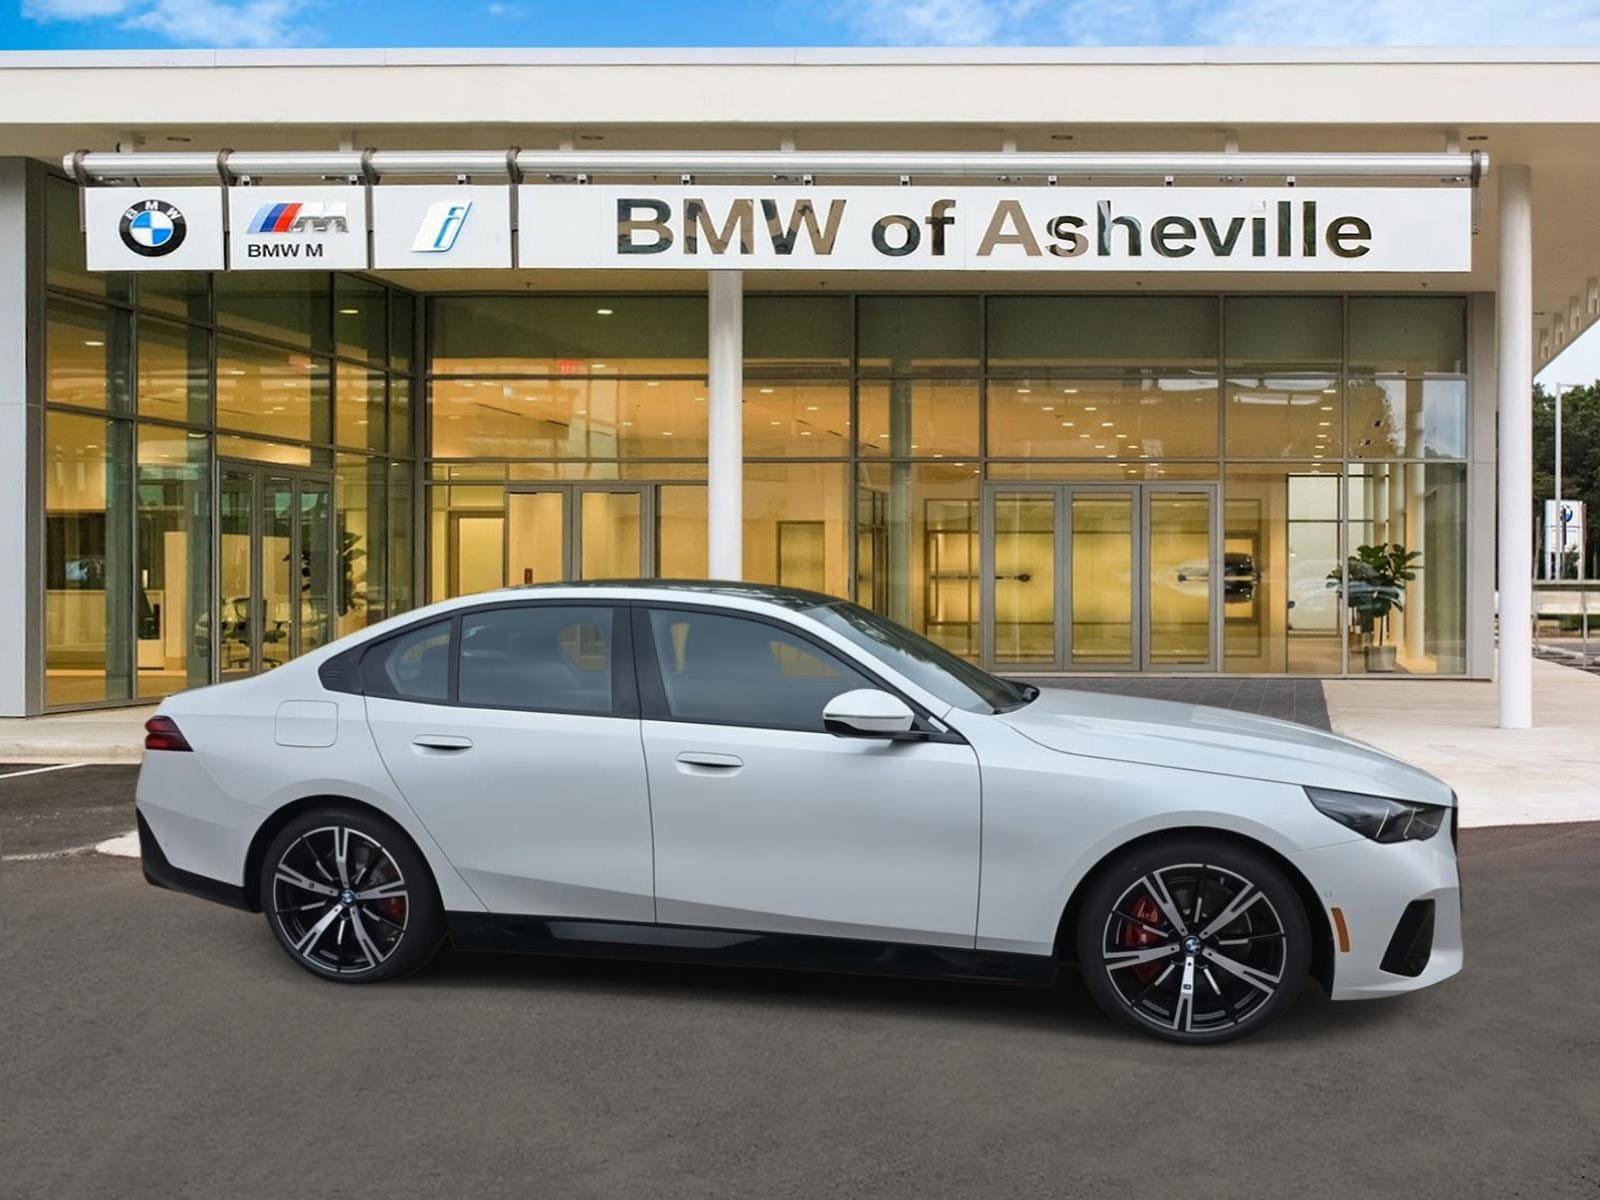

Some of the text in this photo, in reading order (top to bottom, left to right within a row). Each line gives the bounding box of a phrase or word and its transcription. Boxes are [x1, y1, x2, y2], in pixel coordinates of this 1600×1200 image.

[125, 200, 181, 220] BMW
[617, 198, 1372, 258] BMW of Asheville
[247, 243, 324, 258] BMW M
